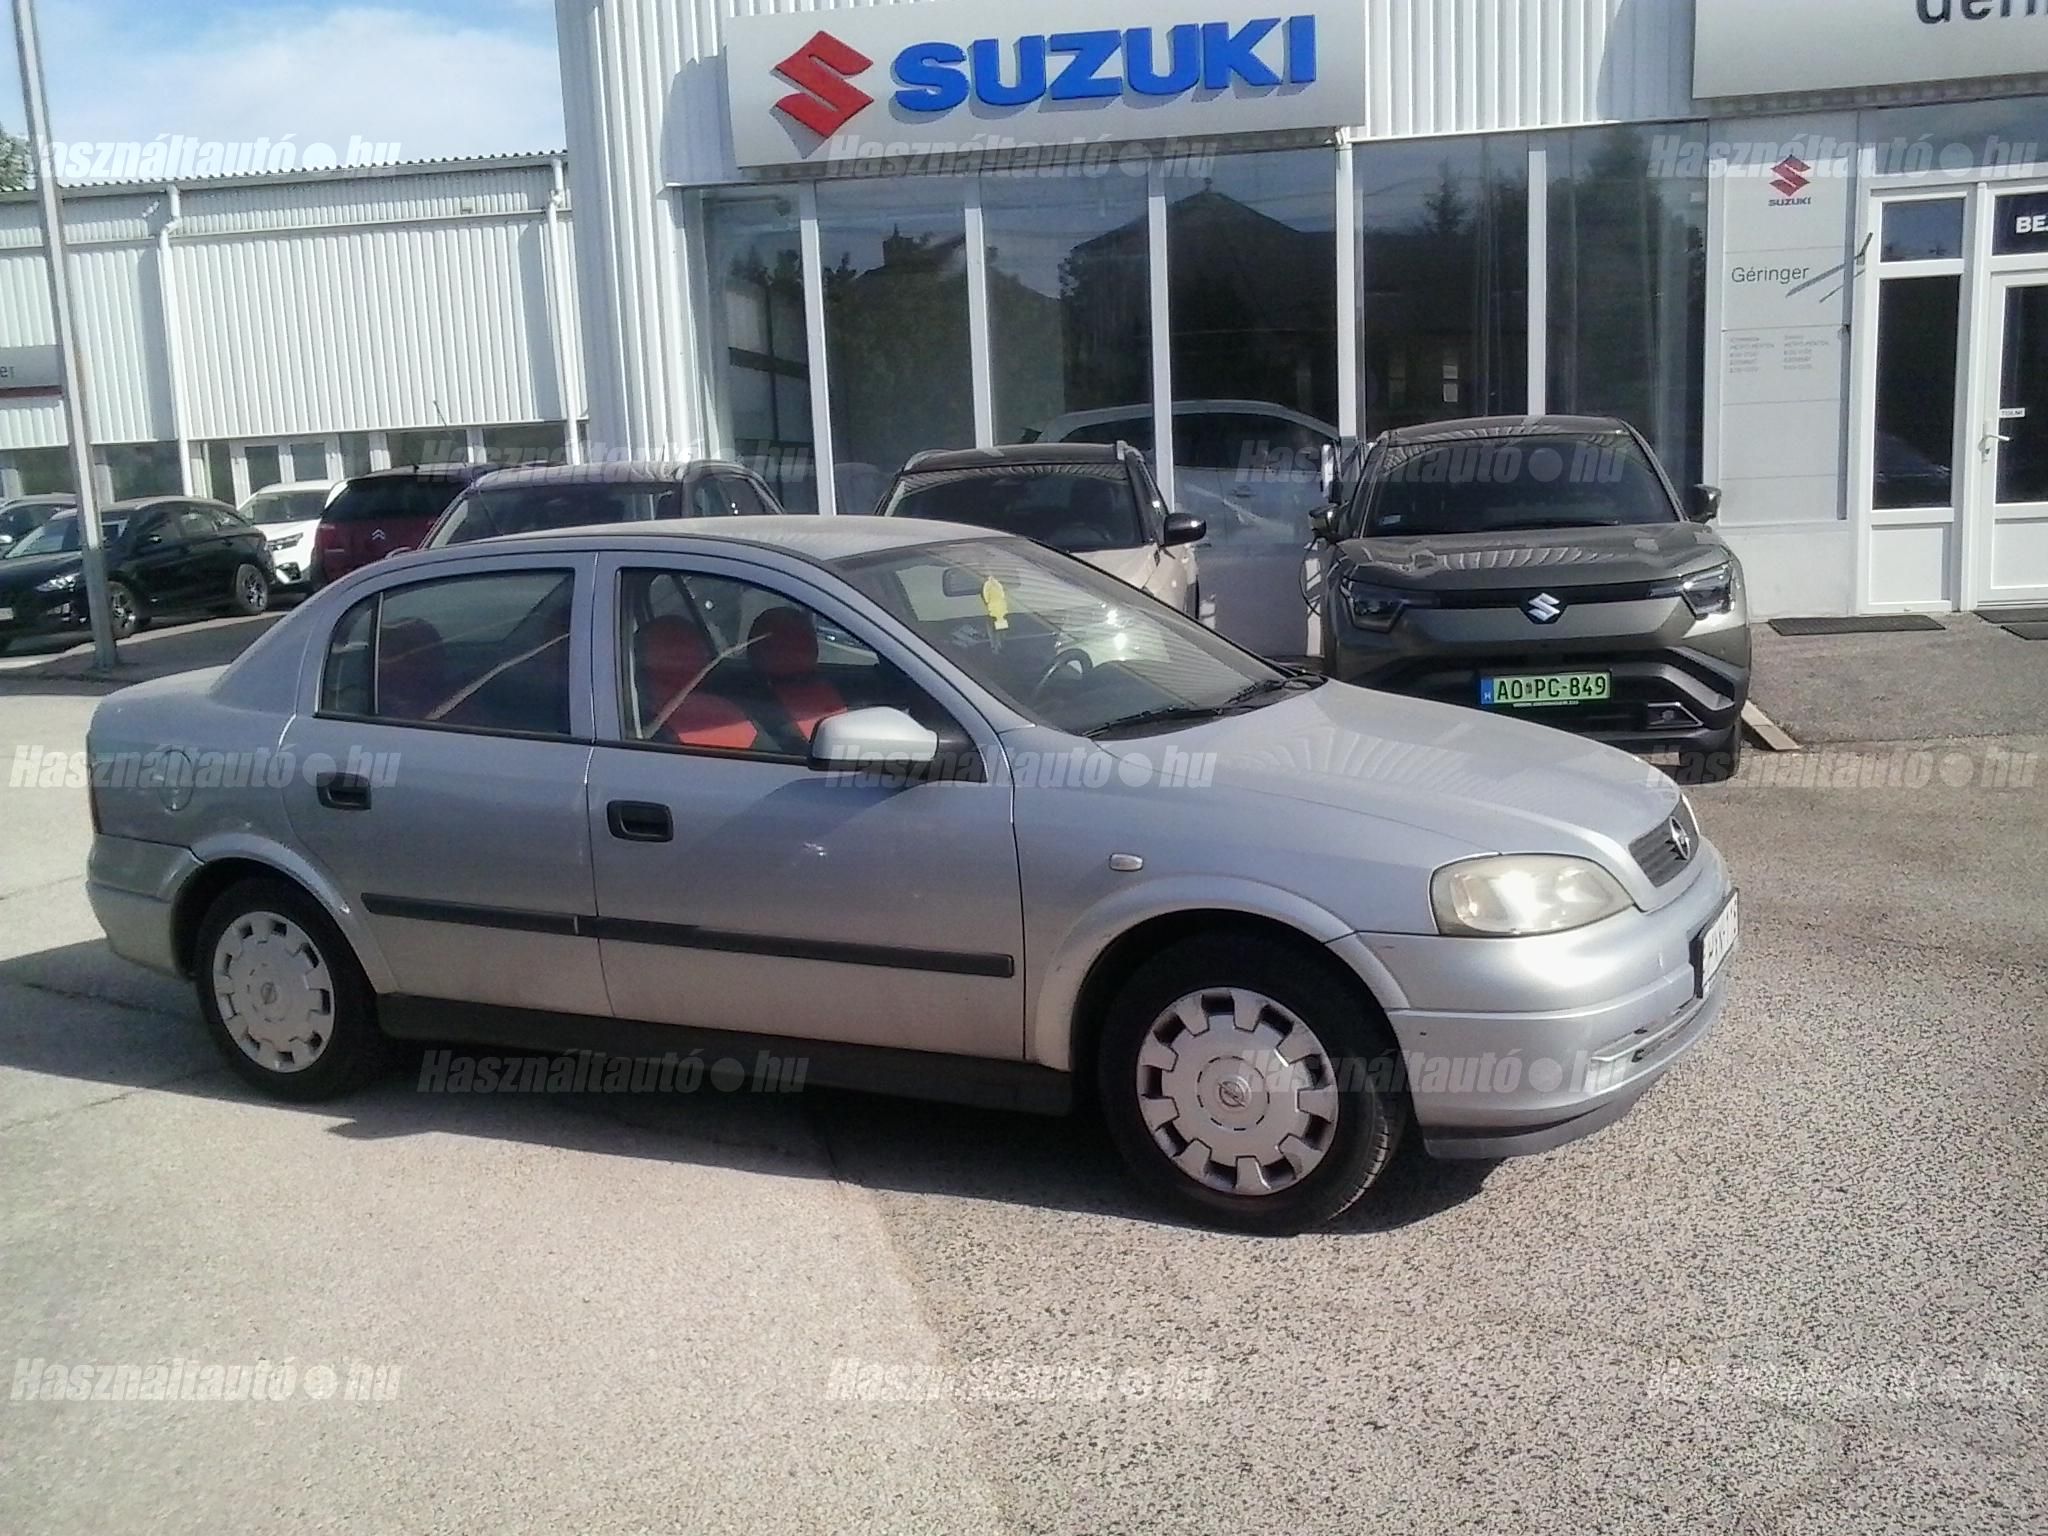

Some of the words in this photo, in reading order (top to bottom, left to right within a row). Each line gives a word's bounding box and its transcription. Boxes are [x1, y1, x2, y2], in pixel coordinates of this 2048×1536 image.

[895, 14, 1317, 113] SUZUKI
[1768, 196, 1811, 207] SUZUKI
[2015, 215, 2048, 234] BE
[1731, 266, 1810, 285] Géringer
